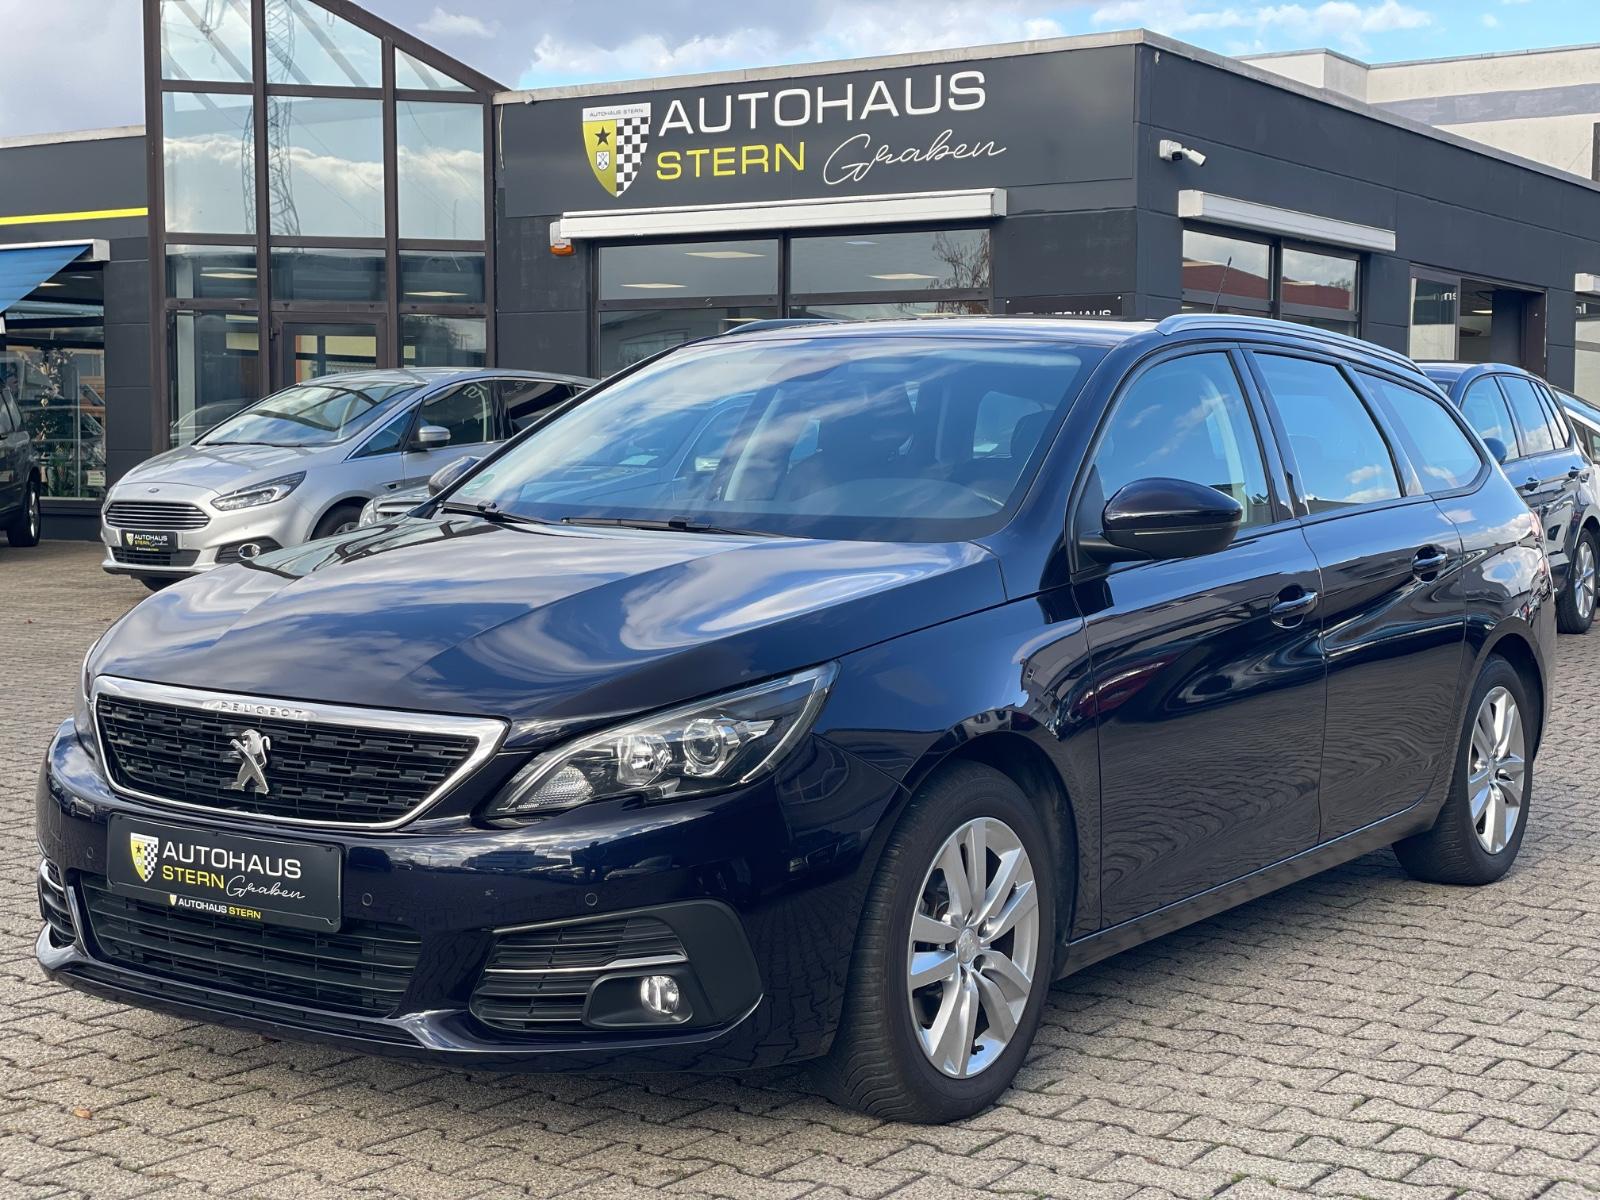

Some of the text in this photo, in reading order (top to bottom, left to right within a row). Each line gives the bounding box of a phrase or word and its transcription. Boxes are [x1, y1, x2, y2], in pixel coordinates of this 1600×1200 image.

[589, 107, 644, 117] AUTOHAUS STERN
[658, 70, 987, 137] AUTOHAUS
[656, 129, 1007, 185] STERN Graben
[134, 534, 168, 542] AUTOHAUS
[221, 701, 302, 718] PEUGEOT
[162, 841, 302, 879] AUTOHAUS
[162, 865, 306, 899] STERN Graben
[178, 898, 261, 920] AUTOHAUS STERN
